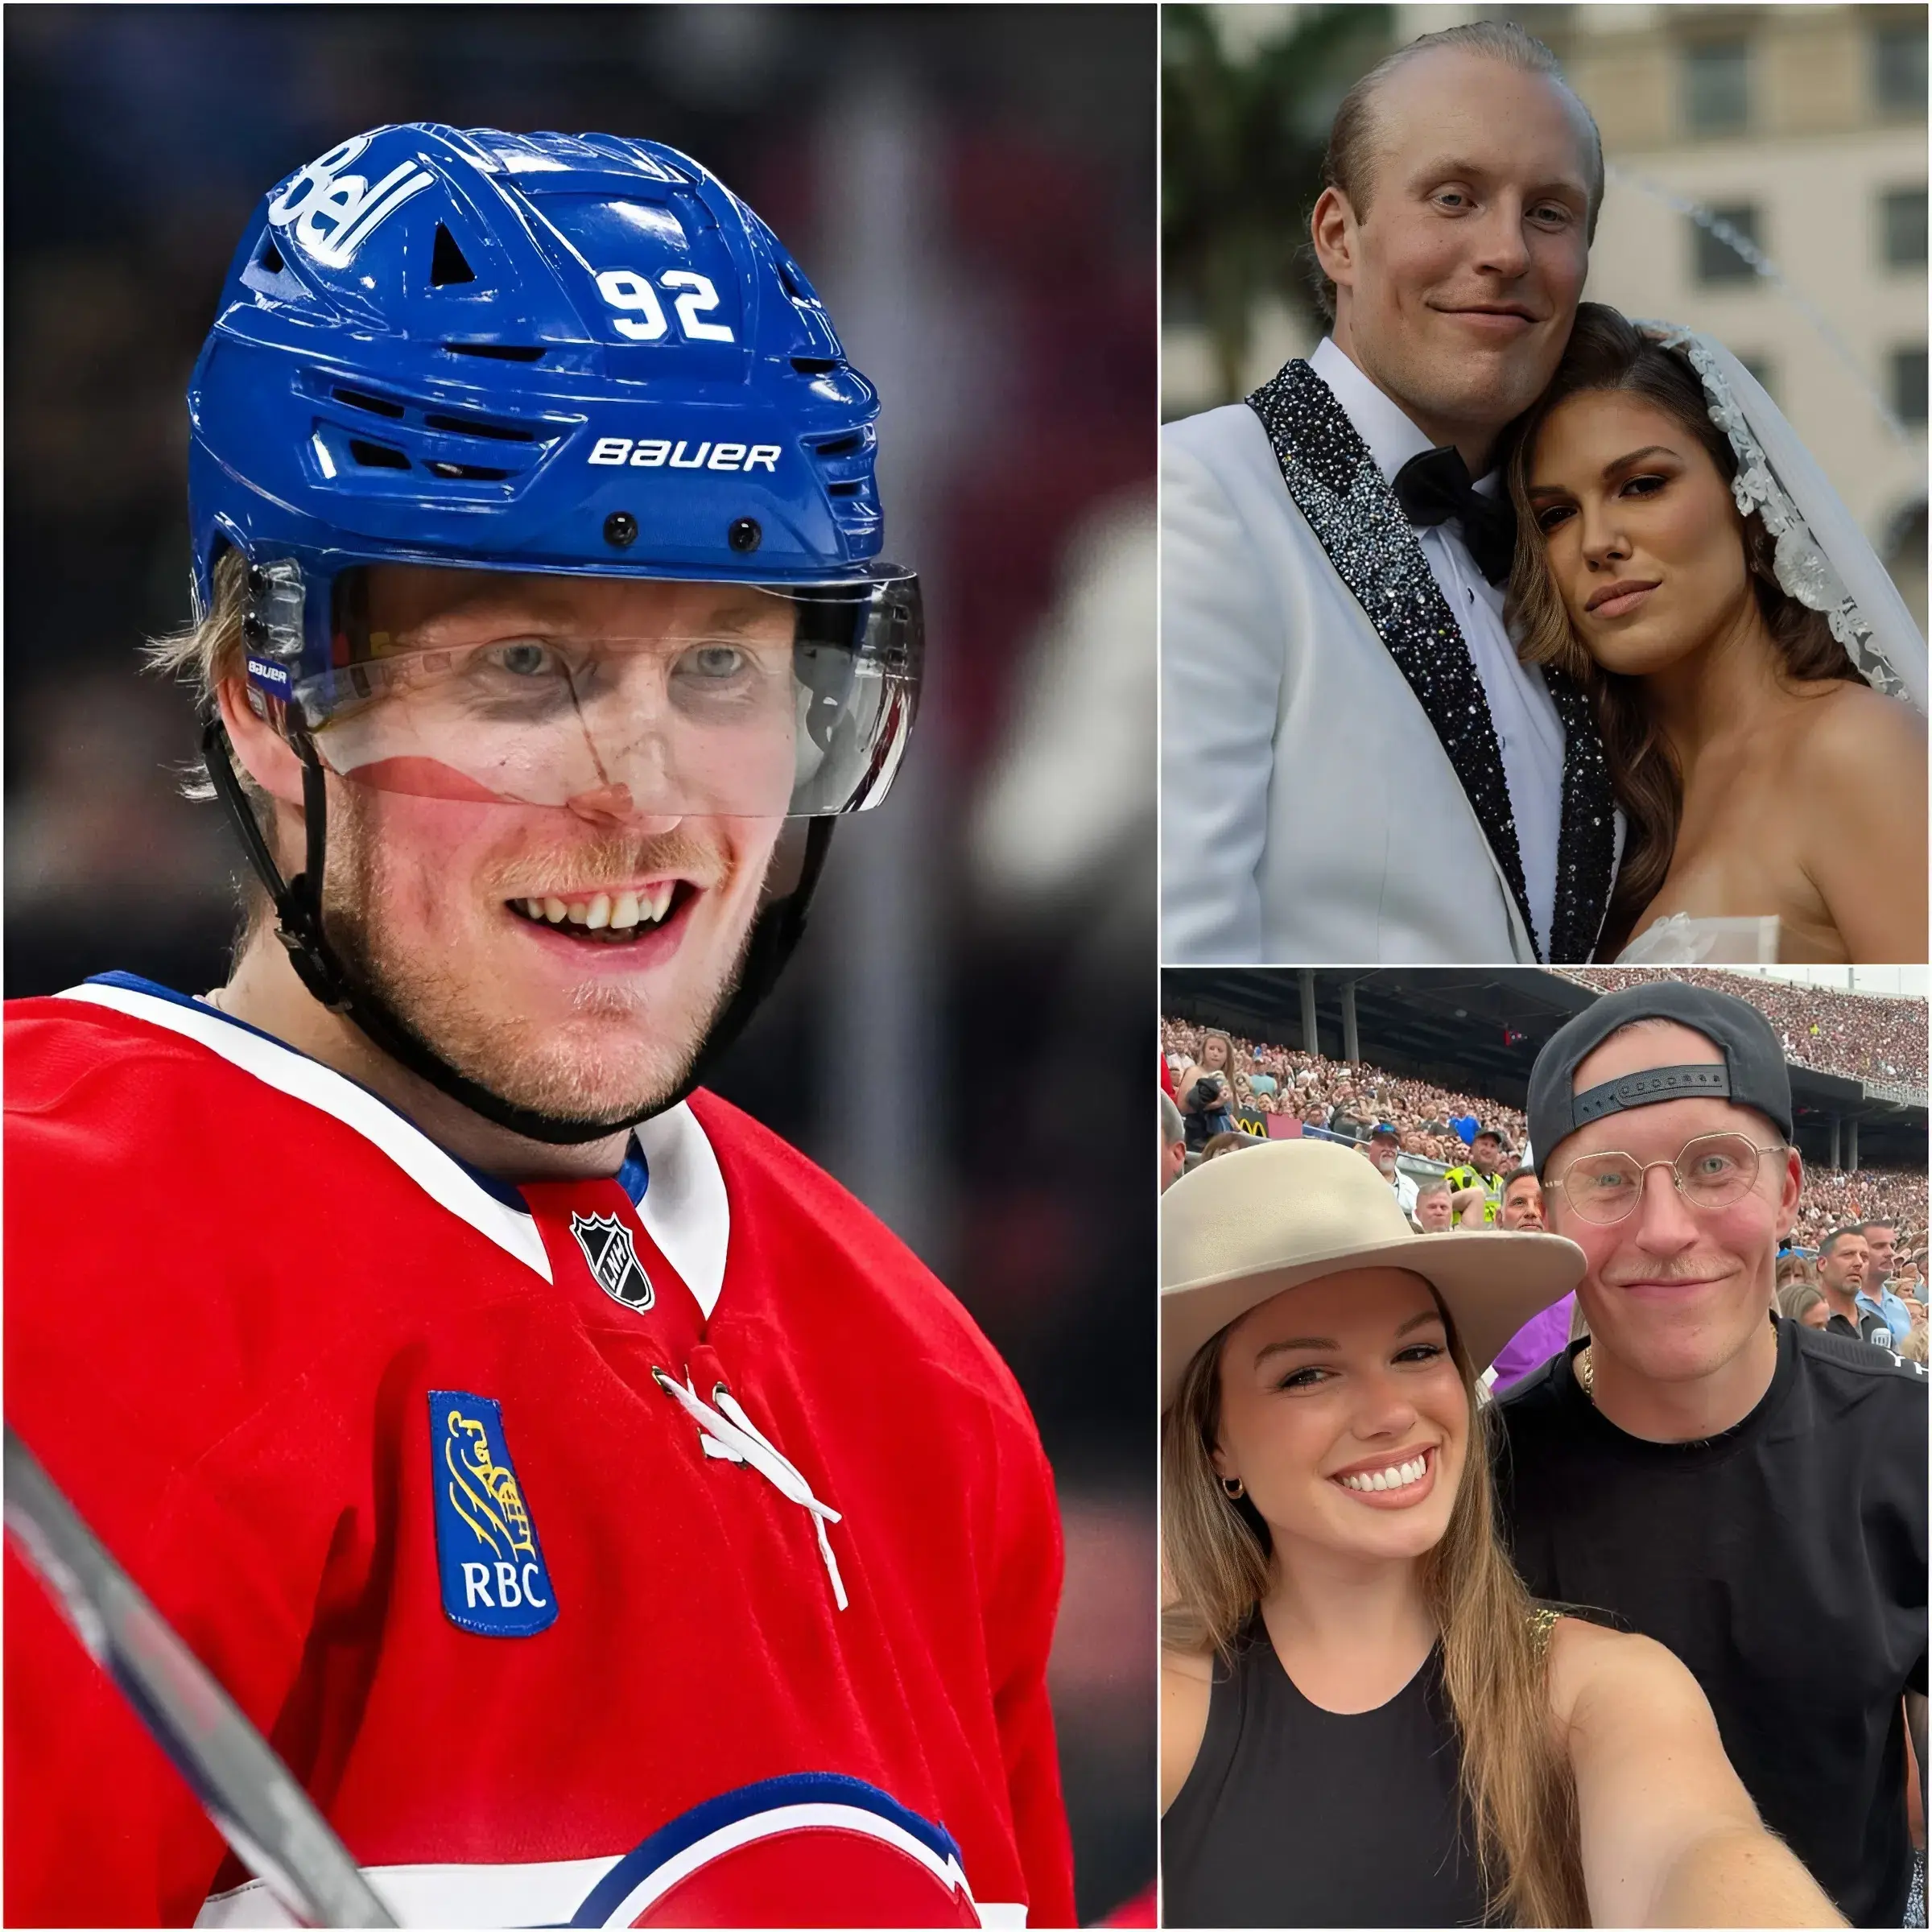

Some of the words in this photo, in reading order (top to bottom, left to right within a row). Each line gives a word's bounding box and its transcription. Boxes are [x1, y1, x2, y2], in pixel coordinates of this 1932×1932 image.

[268, 134, 436, 269] Bell
[596, 270, 734, 342] 92
[602, 1235, 627, 1291] LNH
[460, 1562, 547, 1608] RBC
